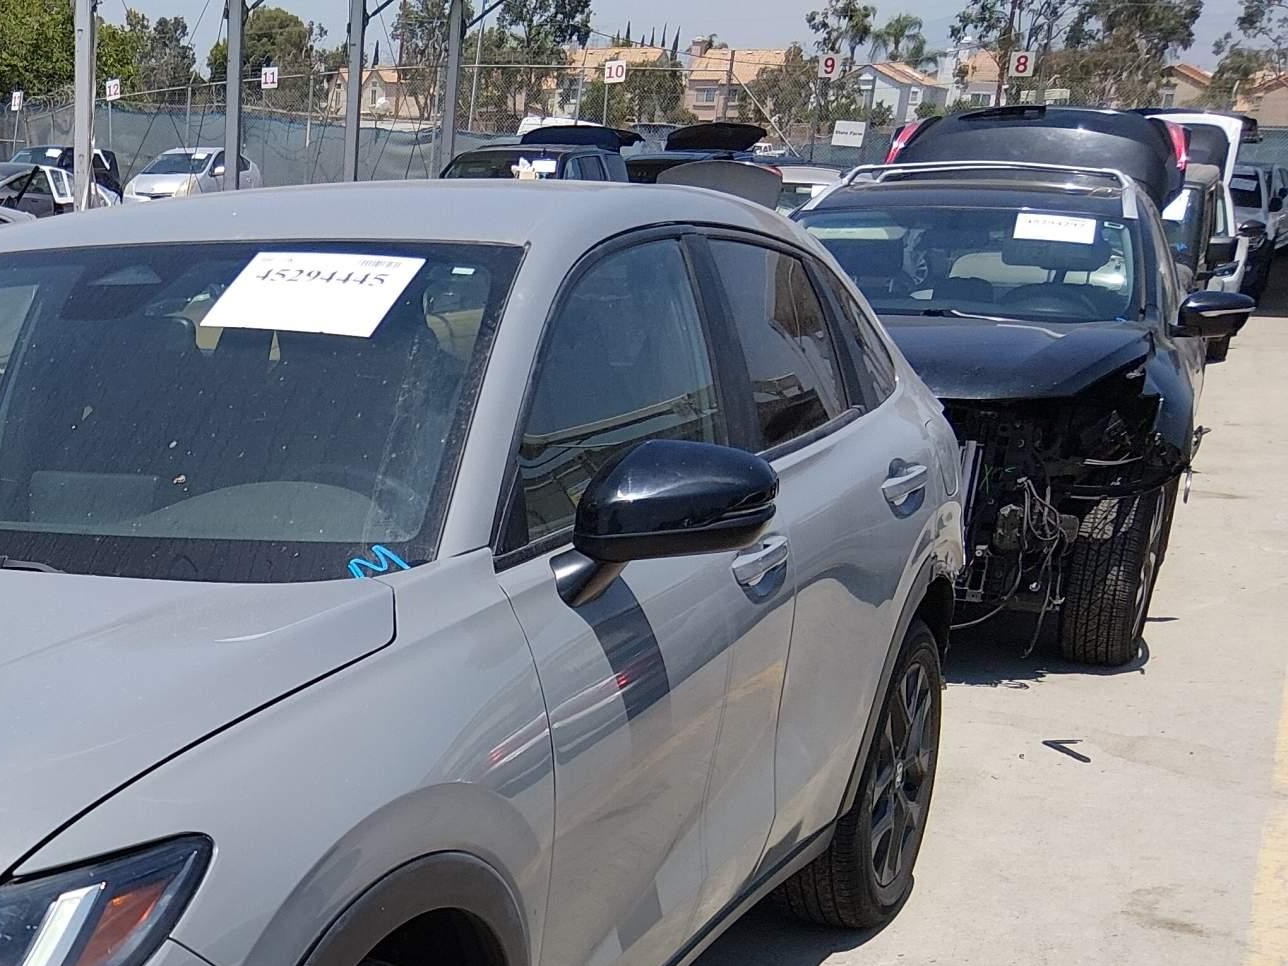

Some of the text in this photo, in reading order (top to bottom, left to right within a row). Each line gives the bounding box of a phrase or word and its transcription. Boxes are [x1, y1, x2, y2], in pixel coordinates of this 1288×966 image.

[824, 57, 836, 74] 9
[1015, 55, 1028, 73] 8
[263, 72, 276, 84] 11
[606, 65, 624, 79] 10
[108, 84, 119, 97] 12
[255, 268, 389, 287] 45294445
